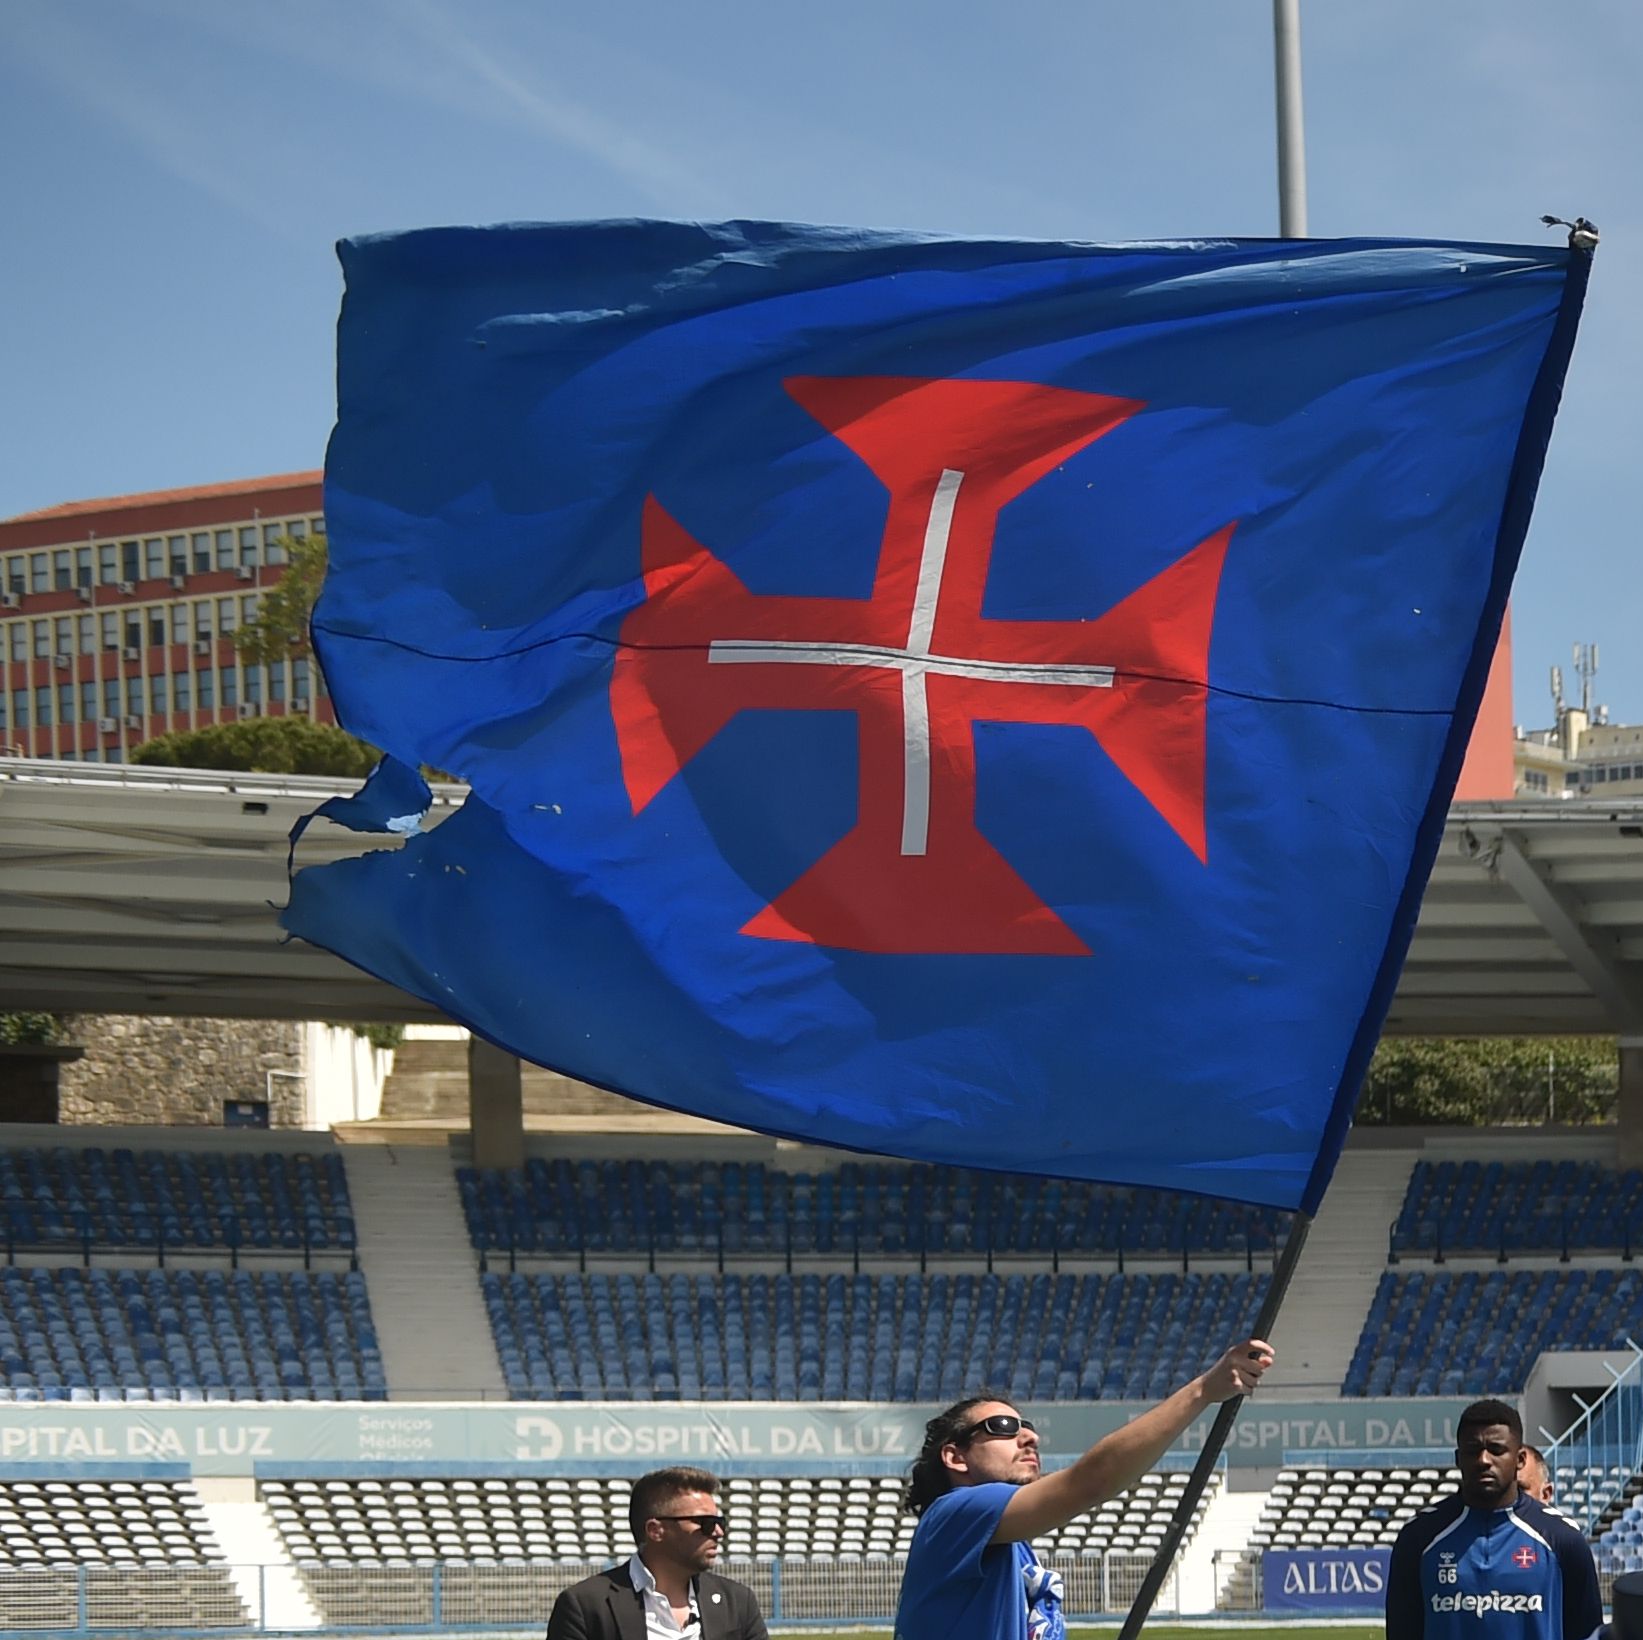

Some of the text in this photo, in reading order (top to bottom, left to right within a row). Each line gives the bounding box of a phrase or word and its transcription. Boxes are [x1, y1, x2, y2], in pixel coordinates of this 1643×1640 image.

[127, 1427, 186, 1456] DA
[197, 1427, 274, 1456] LUZ
[574, 1424, 906, 1455] HOSPITAL DA LUZ
[1365, 1419, 1422, 1445] DA
[1425, 1419, 1457, 1444] LU
[1283, 1559, 1383, 1595] ALTAS
[1438, 1568, 1457, 1584] 66
[1431, 1590, 1543, 1618] telepizza
